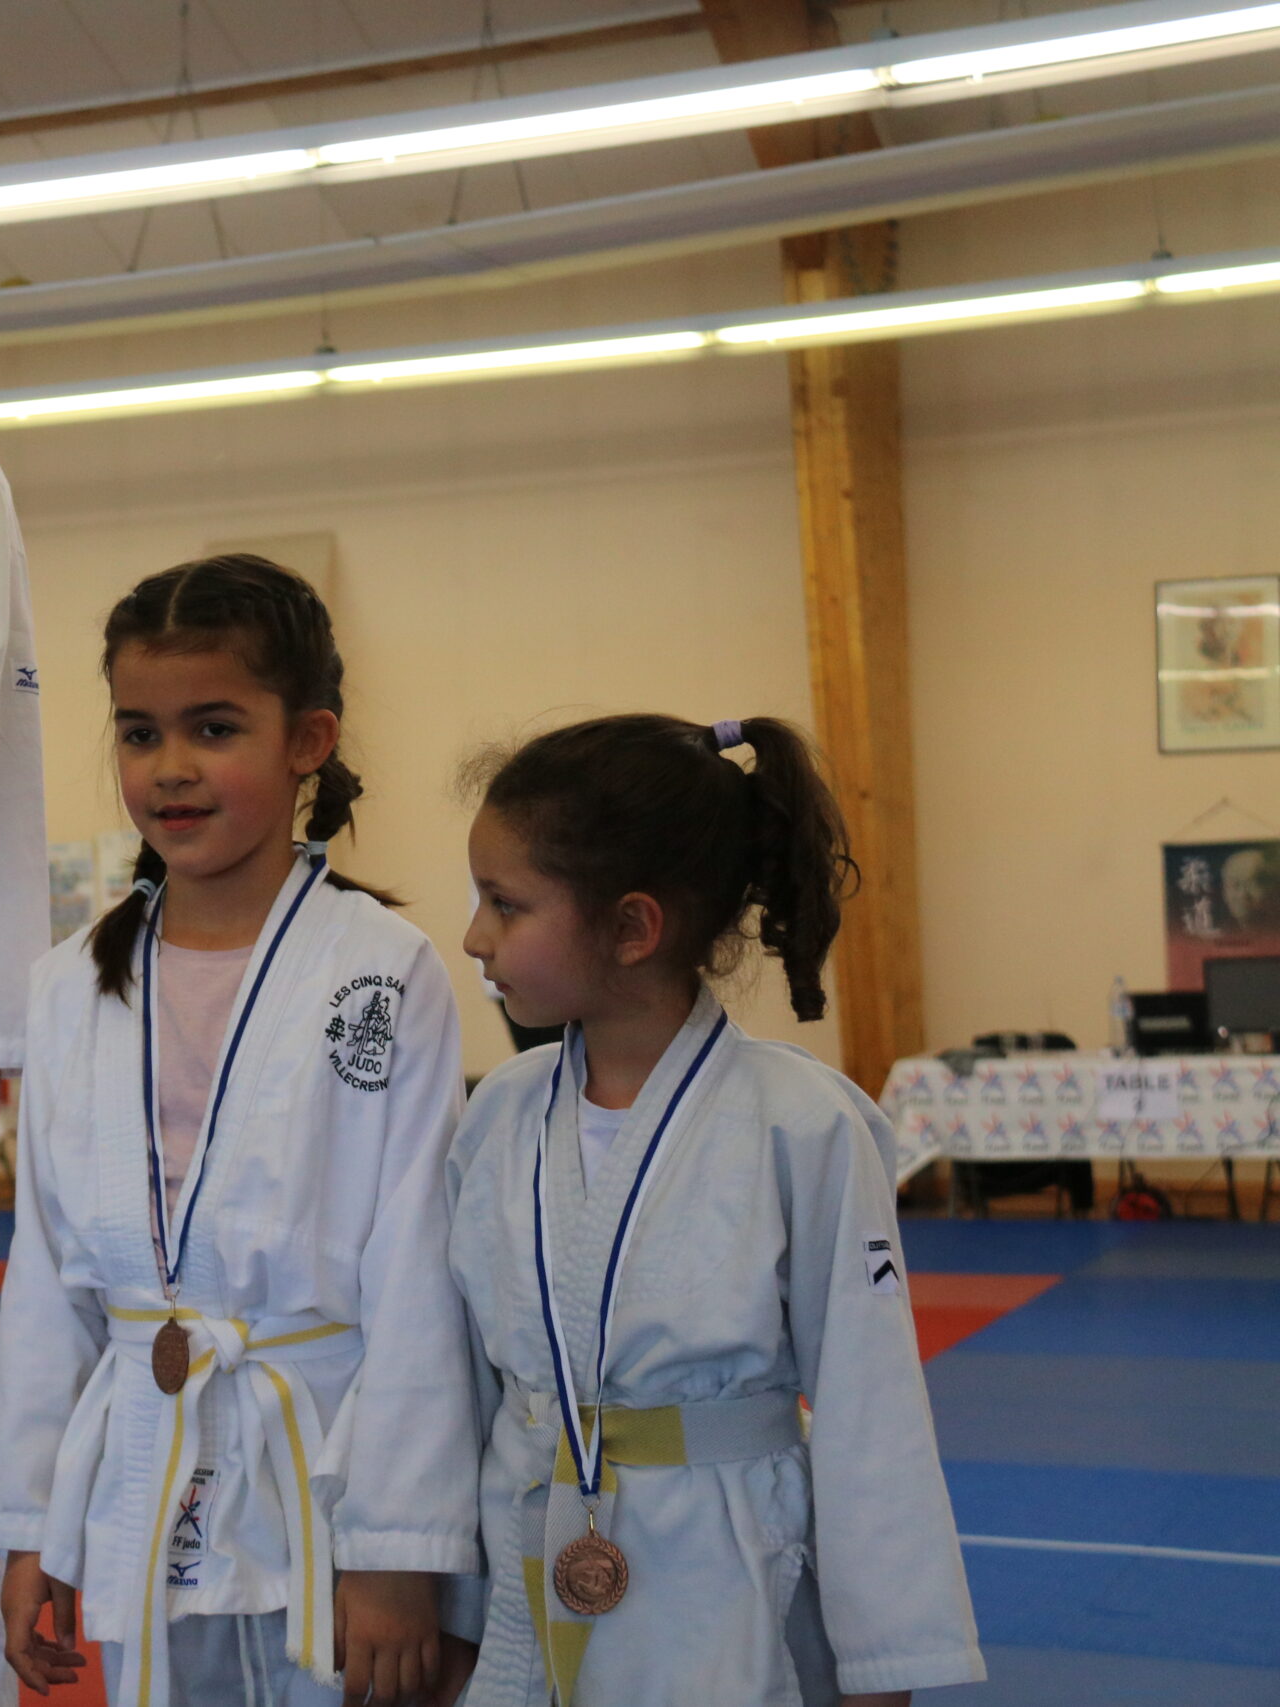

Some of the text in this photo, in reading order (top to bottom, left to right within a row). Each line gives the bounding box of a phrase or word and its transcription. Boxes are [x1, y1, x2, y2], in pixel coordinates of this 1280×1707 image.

[329, 985, 351, 1008] LES
[351, 975, 382, 992] CINQ
[348, 1054, 382, 1075] JUDO
[182, 1537, 201, 1551] judo
